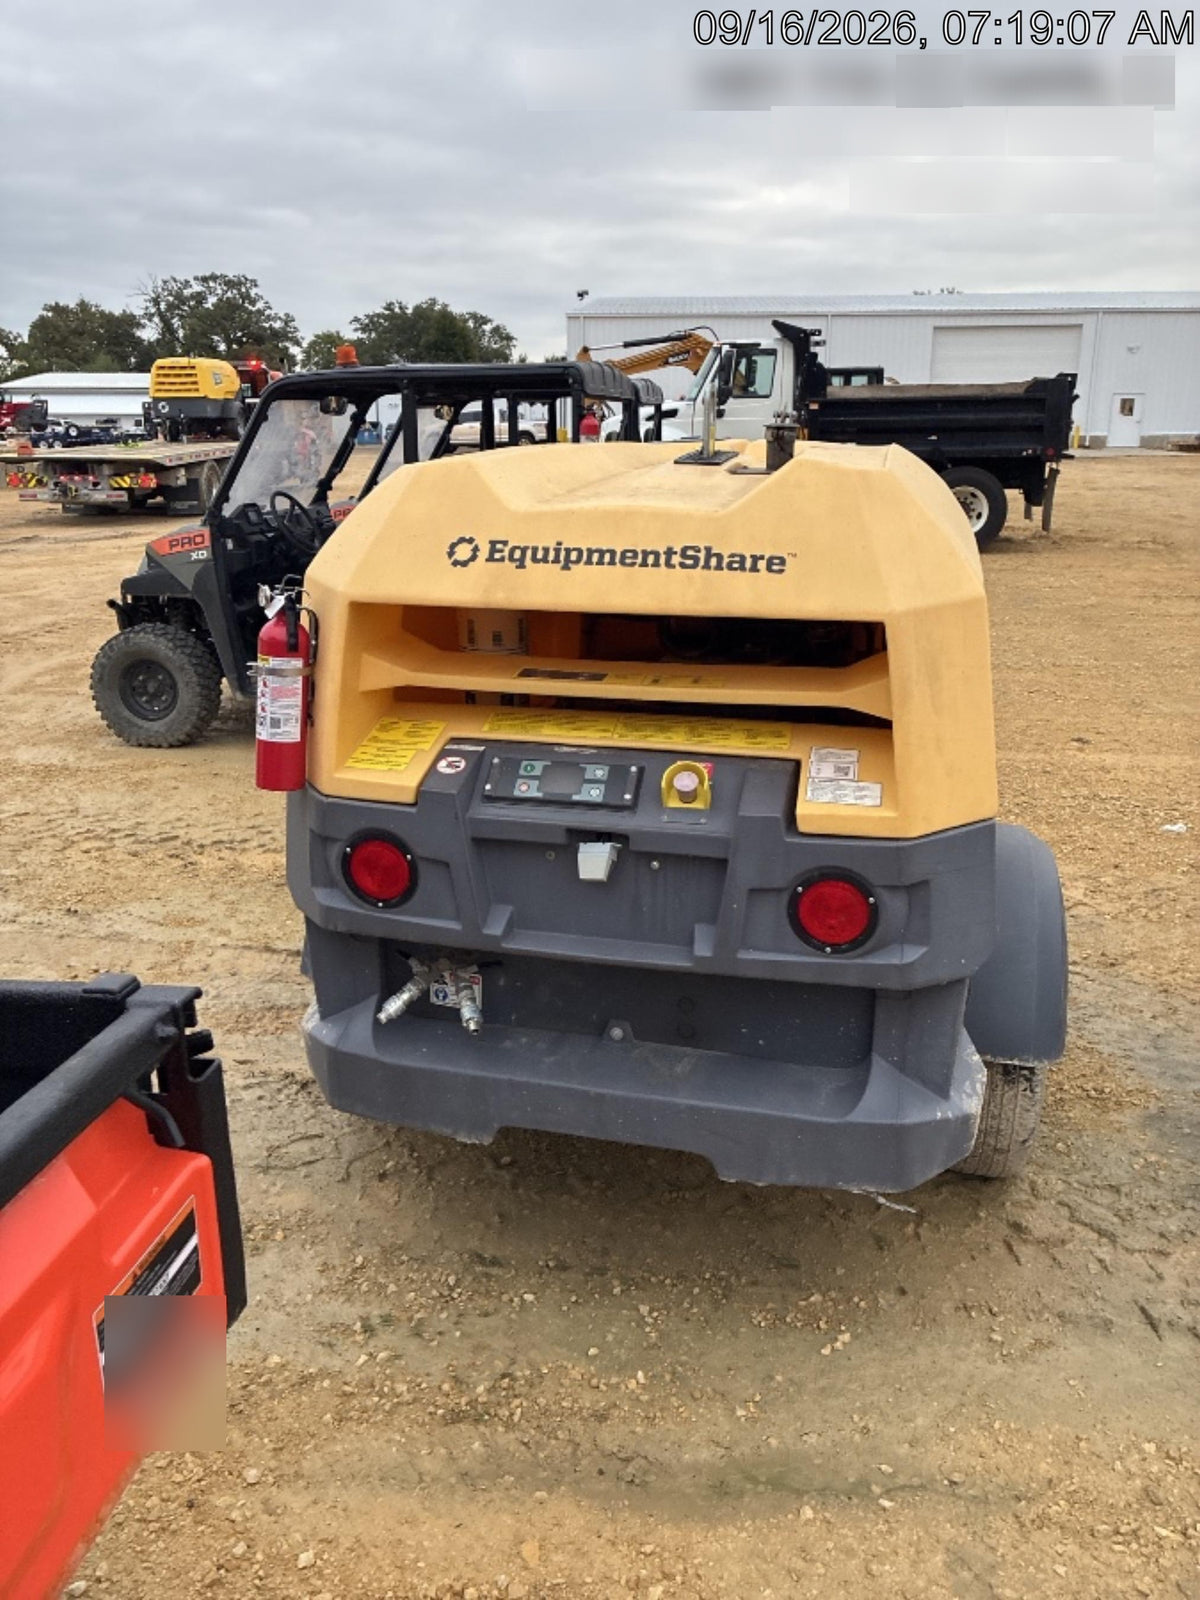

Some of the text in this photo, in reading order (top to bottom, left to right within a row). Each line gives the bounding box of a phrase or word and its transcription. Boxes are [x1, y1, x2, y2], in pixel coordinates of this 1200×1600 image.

[168, 533, 205, 551] PRO
[190, 550, 207, 560] XD
[485, 539, 787, 574] EquipmentShare
